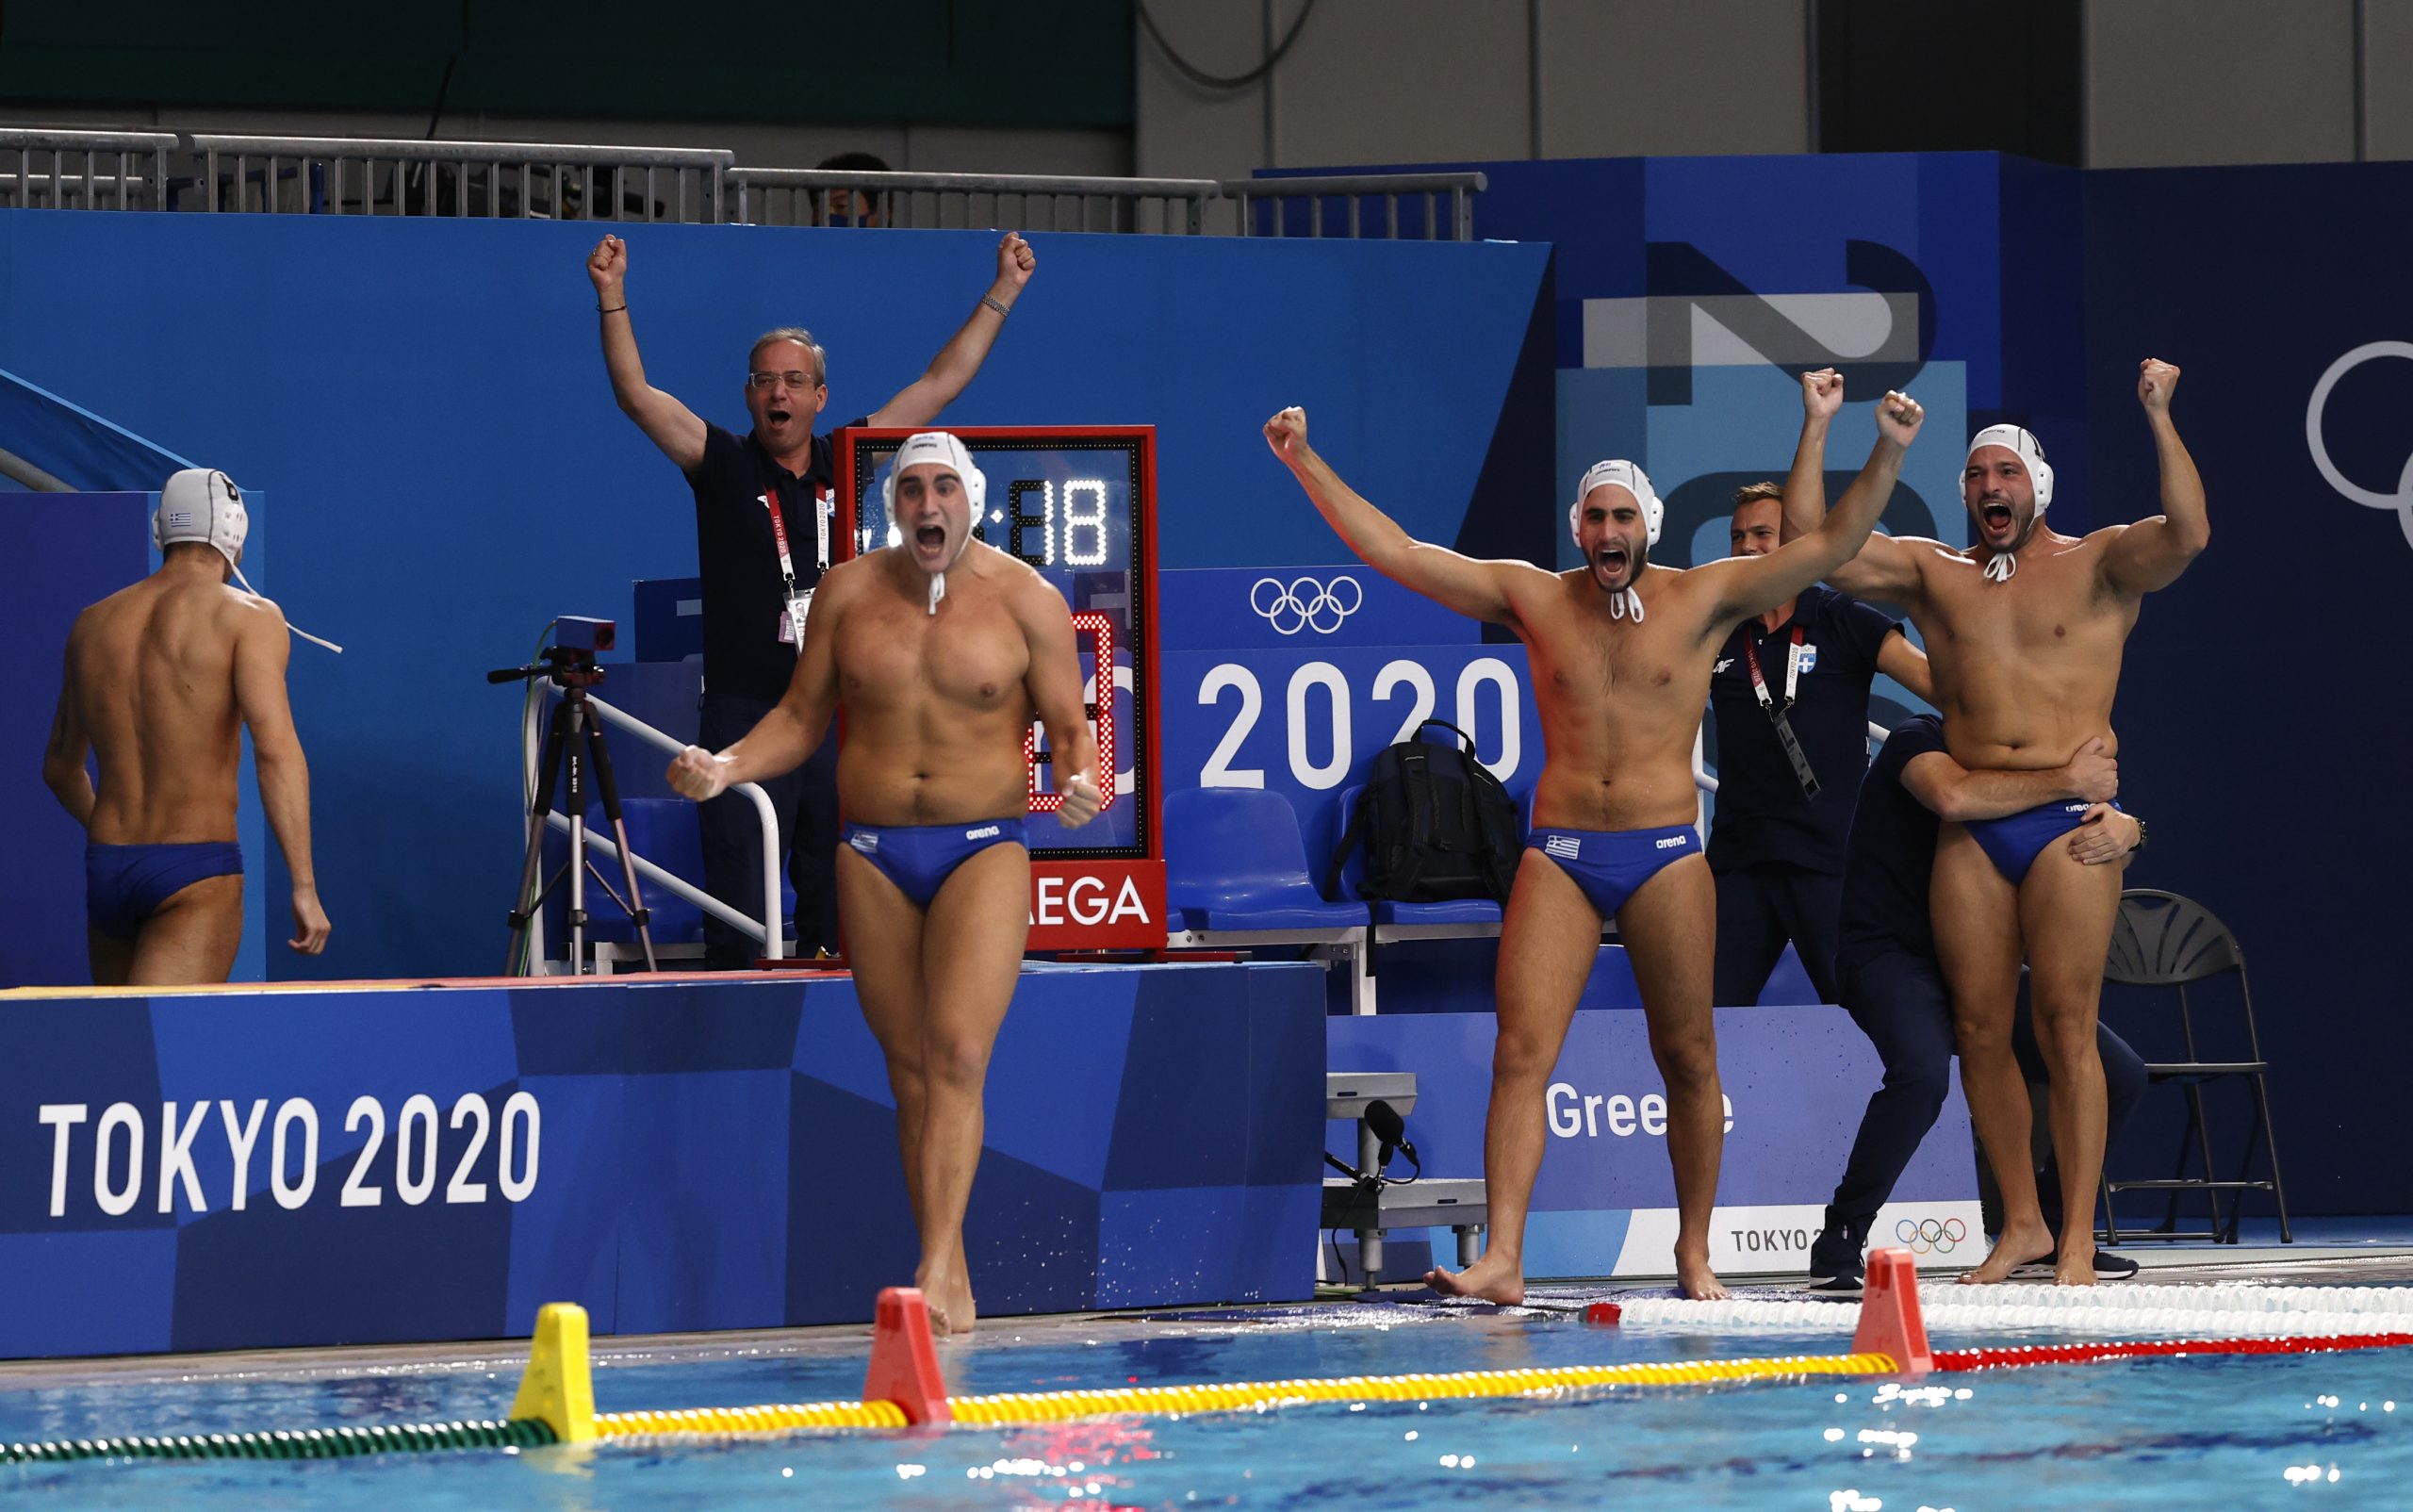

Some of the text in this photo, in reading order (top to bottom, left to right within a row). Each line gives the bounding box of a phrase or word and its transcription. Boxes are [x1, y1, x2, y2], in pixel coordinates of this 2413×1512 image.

[773, 515, 787, 553] TOKYO 2020
[1197, 657, 1521, 790] 2020
[966, 825, 1000, 841] arena
[1656, 835, 1687, 848] arena
[1029, 875, 1150, 925] EGA
[39, 1092, 541, 1217] TOKYO 2020
[1732, 1228, 1807, 1252] TOKYO
